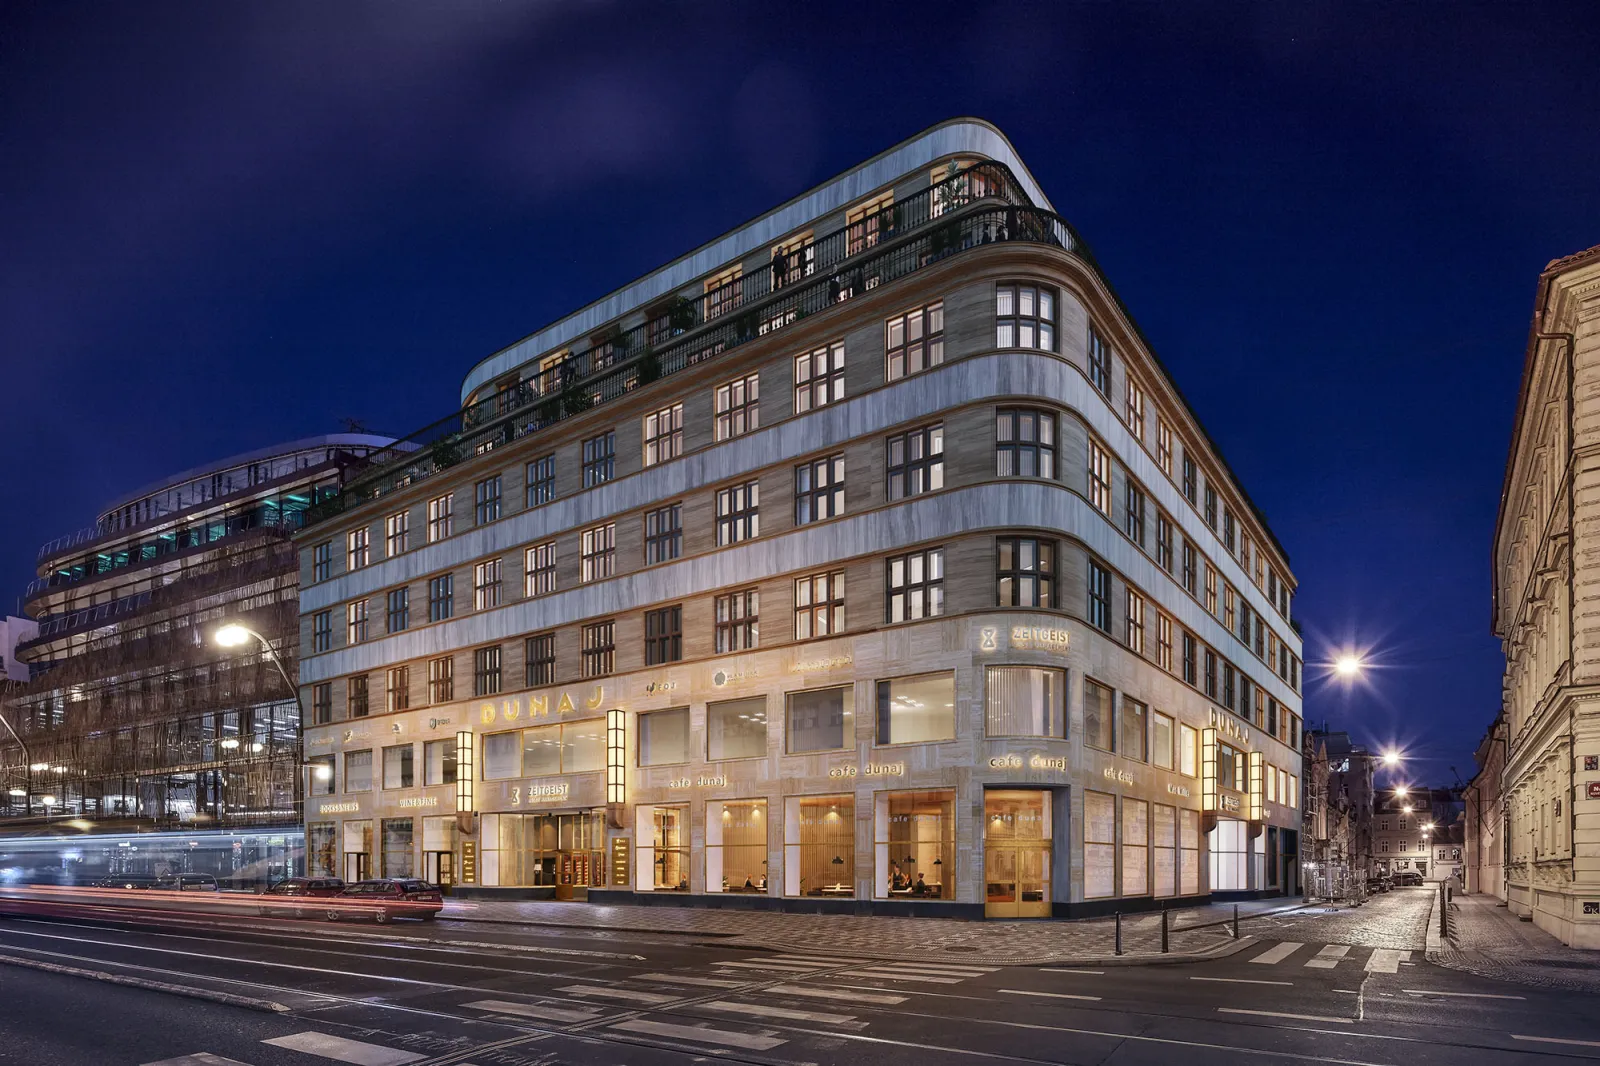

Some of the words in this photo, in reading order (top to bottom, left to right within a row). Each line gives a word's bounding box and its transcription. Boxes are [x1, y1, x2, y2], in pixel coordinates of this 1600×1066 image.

[1012, 627, 1070, 644] ZEITGEIST
[480, 685, 604, 724] DUNAJ
[1208, 706, 1249, 744] DUNAJ
[829, 765, 857, 777] cafe
[865, 763, 904, 777] dunaj
[989, 756, 1022, 769] cafe
[1030, 755, 1068, 771] dunaj
[669, 776, 690, 788] cafe
[696, 775, 727, 788] dunaj
[528, 785, 568, 796] ZEITGEIST
